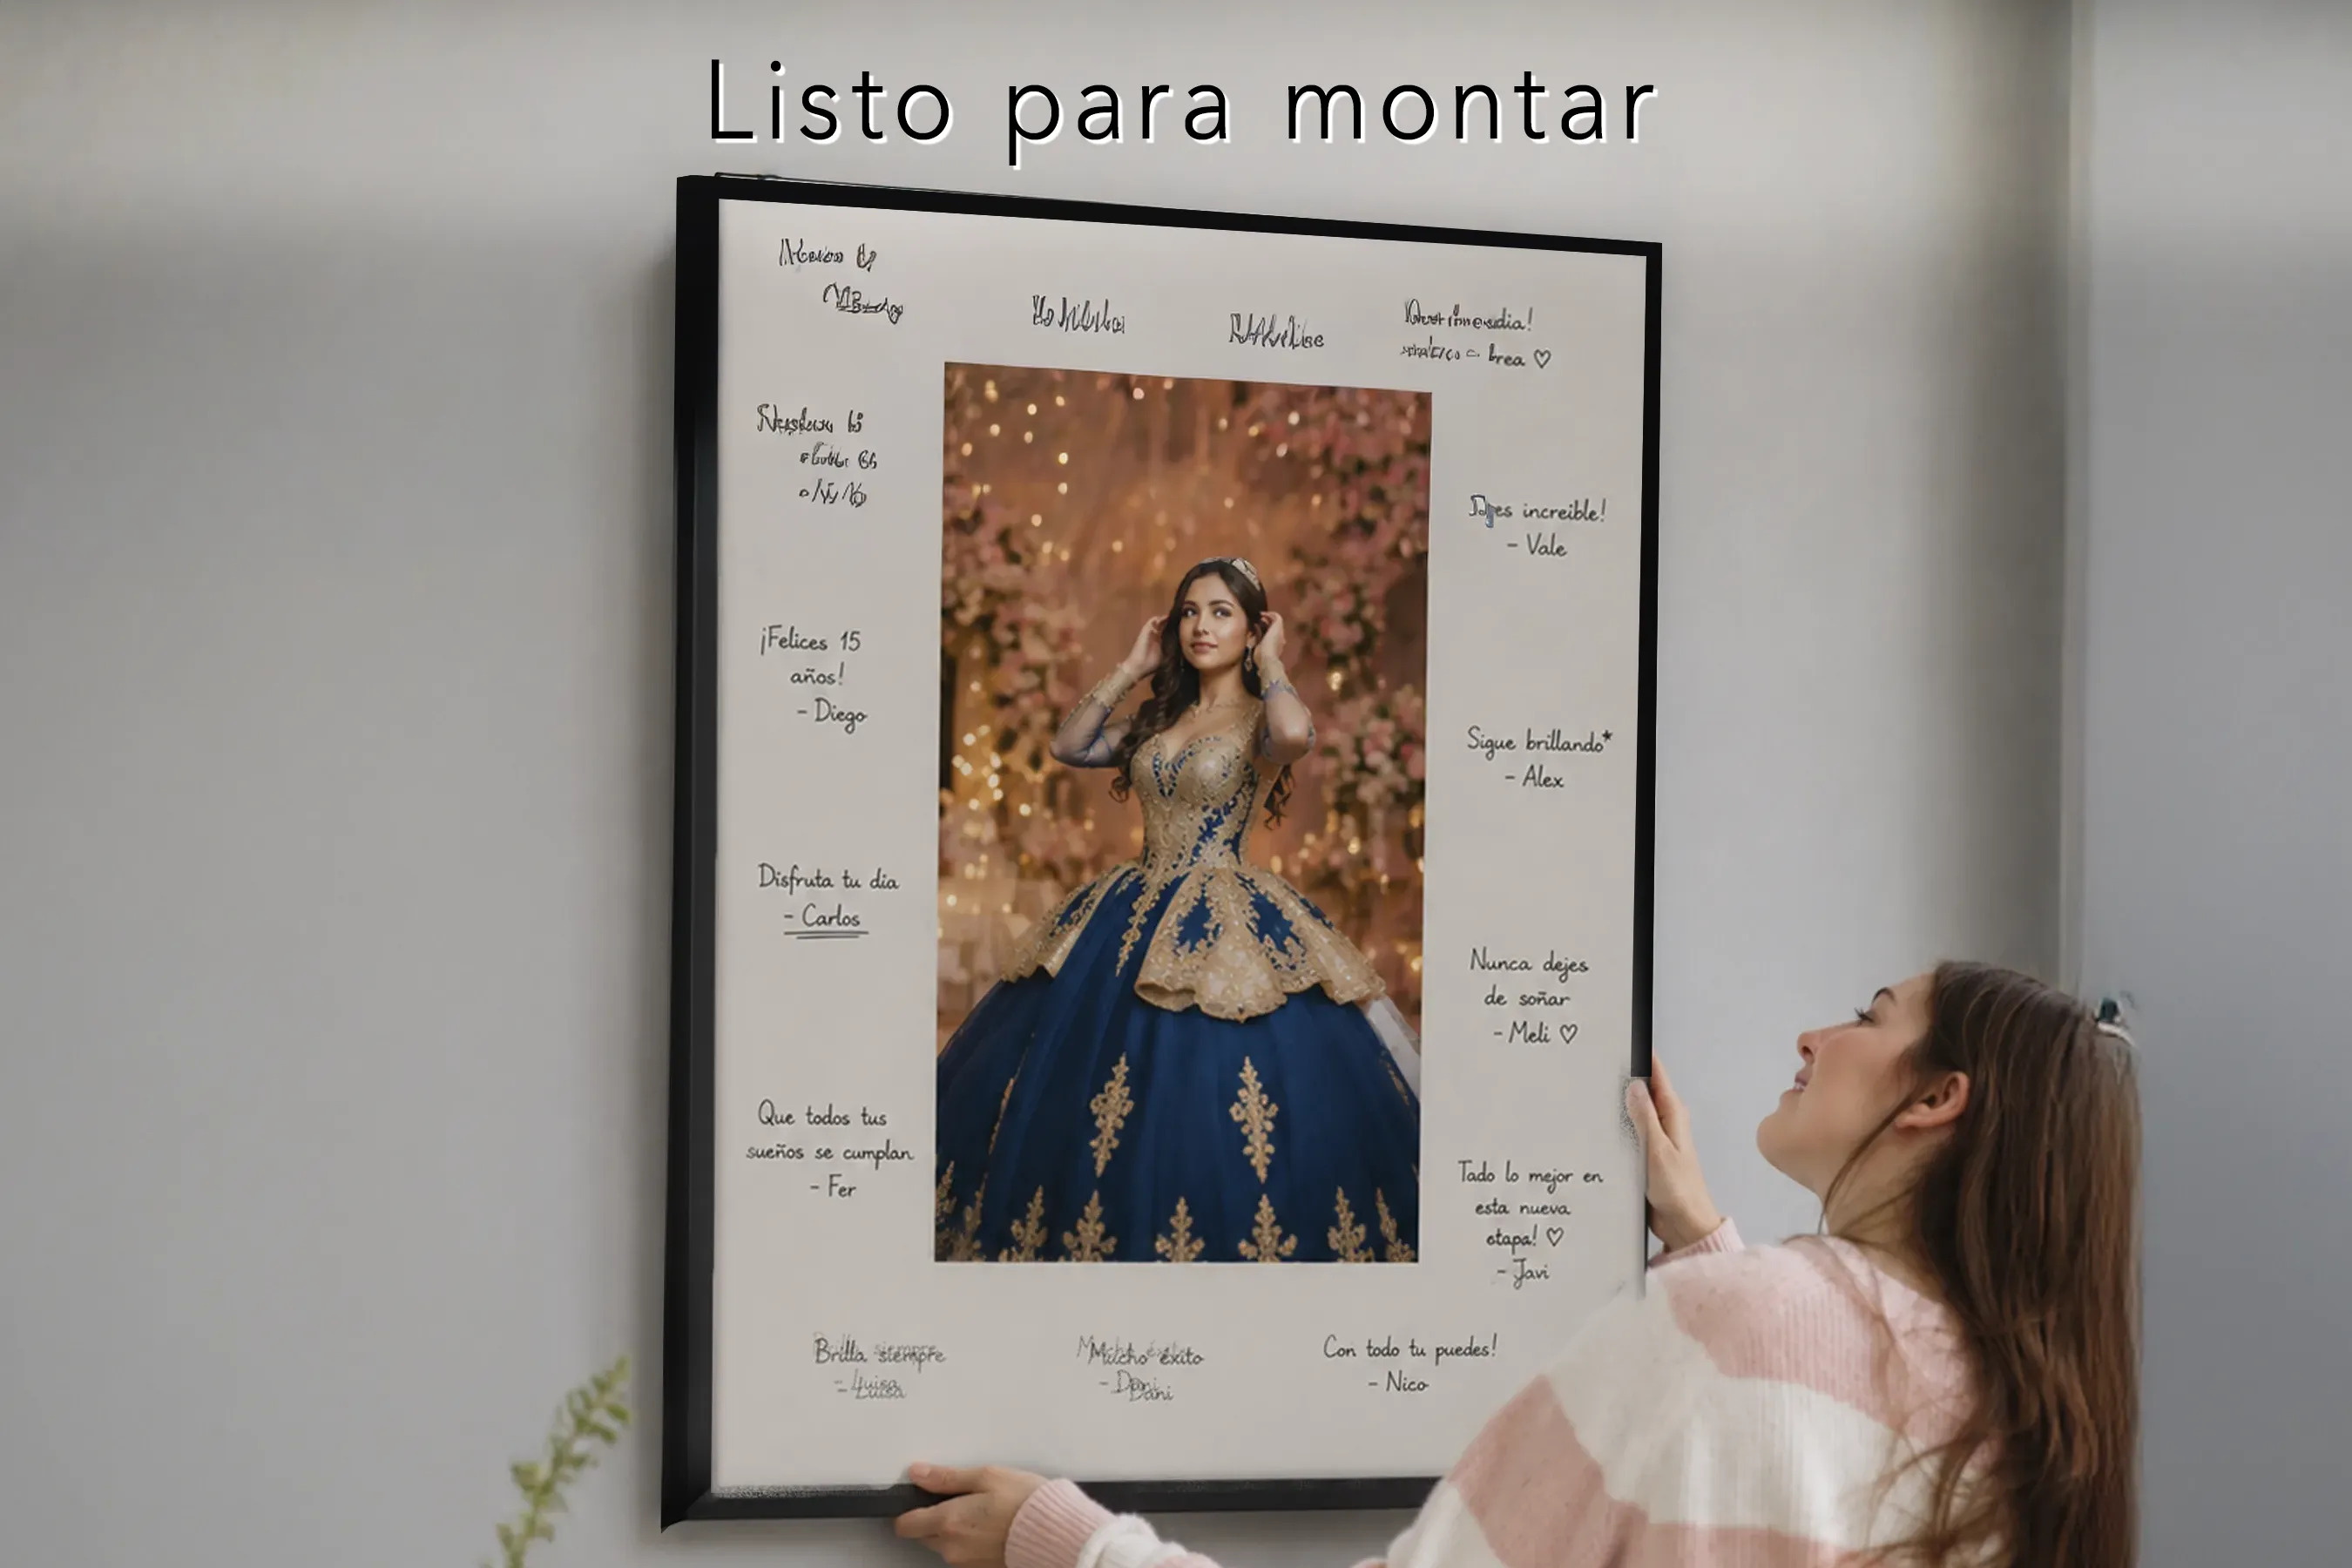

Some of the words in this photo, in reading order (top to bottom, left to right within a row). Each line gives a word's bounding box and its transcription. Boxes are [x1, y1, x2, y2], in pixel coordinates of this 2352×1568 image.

[1526, 531, 1568, 558] Vale
[760, 624, 828, 656] ¡Felices
[840, 630, 862, 652] 15
[789, 661, 845, 686] años!
[814, 696, 868, 735] Diego
[1467, 725, 1517, 761] Sigue
[1522, 763, 1565, 788] Alex
[757, 862, 835, 896] Disfruta
[841, 868, 862, 889] tu
[801, 902, 861, 928] Carlos
[1470, 946, 1533, 971] Nunca
[1543, 950, 1590, 984] dejes
[1484, 983, 1508, 1006] de
[1518, 990, 1571, 1007] soñar
[1508, 1020, 1551, 1044] Meli
[758, 1098, 796, 1127] Que
[805, 1103, 851, 1126] todos
[860, 1105, 888, 1126] tus
[746, 1143, 805, 1160] sueños
[814, 1147, 835, 1160] se
[842, 1138, 915, 1171] cumplan
[828, 1173, 857, 1199] Fer
[1504, 1159, 1520, 1183] lo
[1528, 1168, 1574, 1195] mejor
[1582, 1172, 1604, 1184] en
[1475, 1197, 1511, 1215] esta
[1519, 1204, 1571, 1216] nueva
[1512, 1257, 1550, 1290] Javi
[1323, 1334, 1357, 1359] Con
[1365, 1335, 1401, 1358] todo
[1408, 1338, 1427, 1357] tu
[1435, 1332, 1497, 1367] puedes!
[1385, 1369, 1429, 1392] Nico
